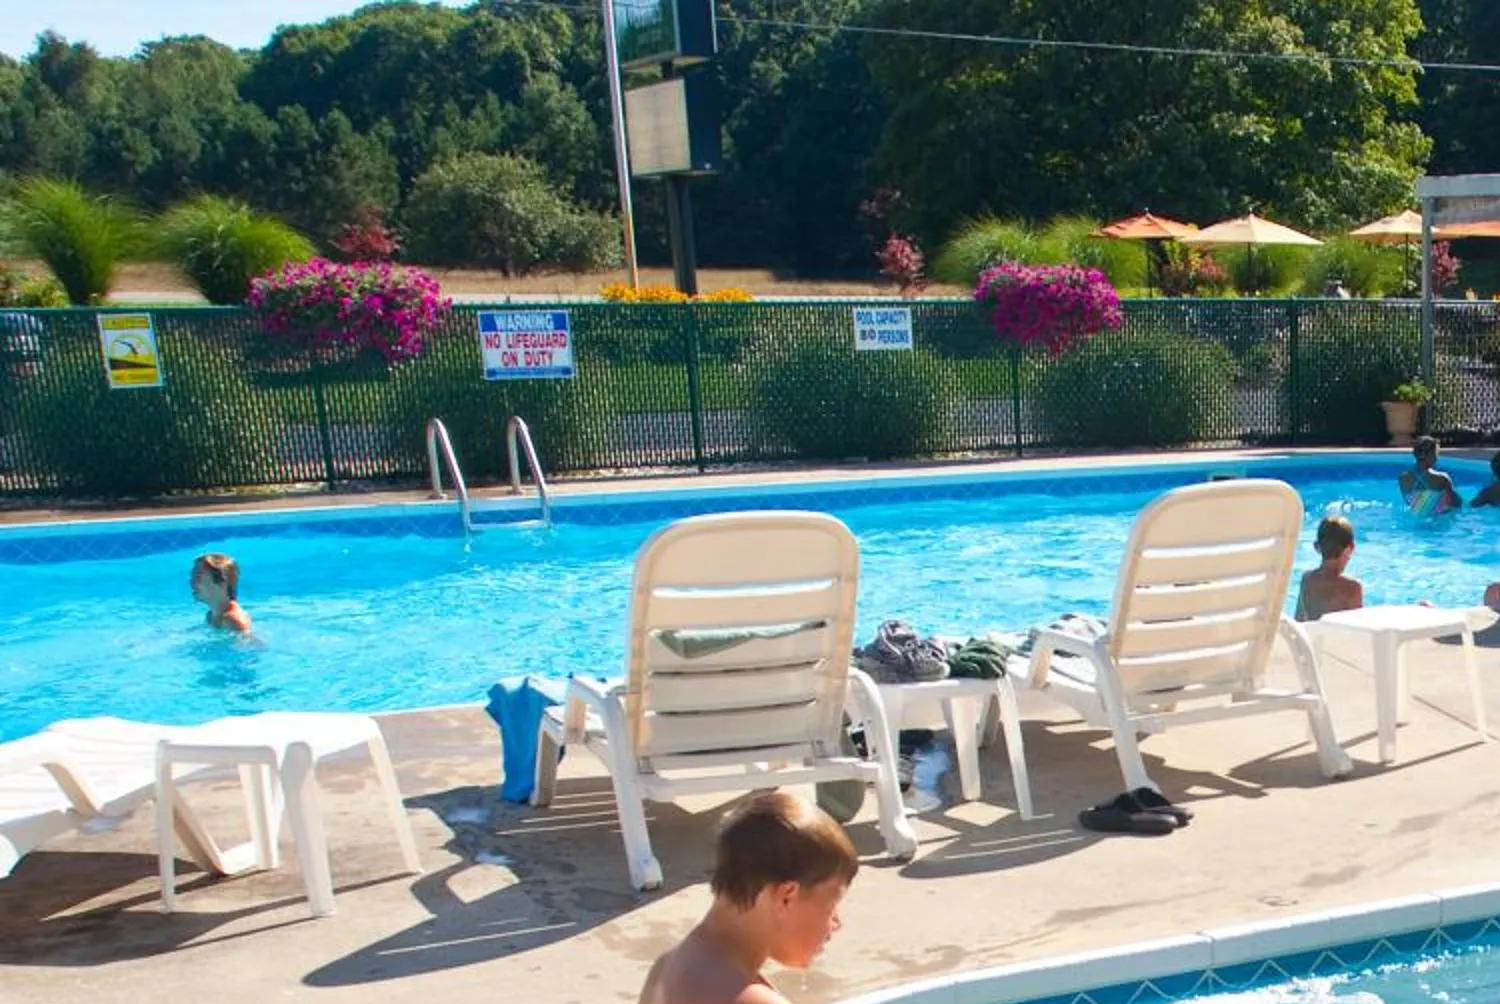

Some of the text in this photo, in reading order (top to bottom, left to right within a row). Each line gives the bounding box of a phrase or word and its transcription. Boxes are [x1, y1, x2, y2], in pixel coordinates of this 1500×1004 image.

[494, 312, 554, 331] WARNING
[484, 332, 567, 349] NO LIFEGUARD
[501, 351, 553, 367] ON DUTY
